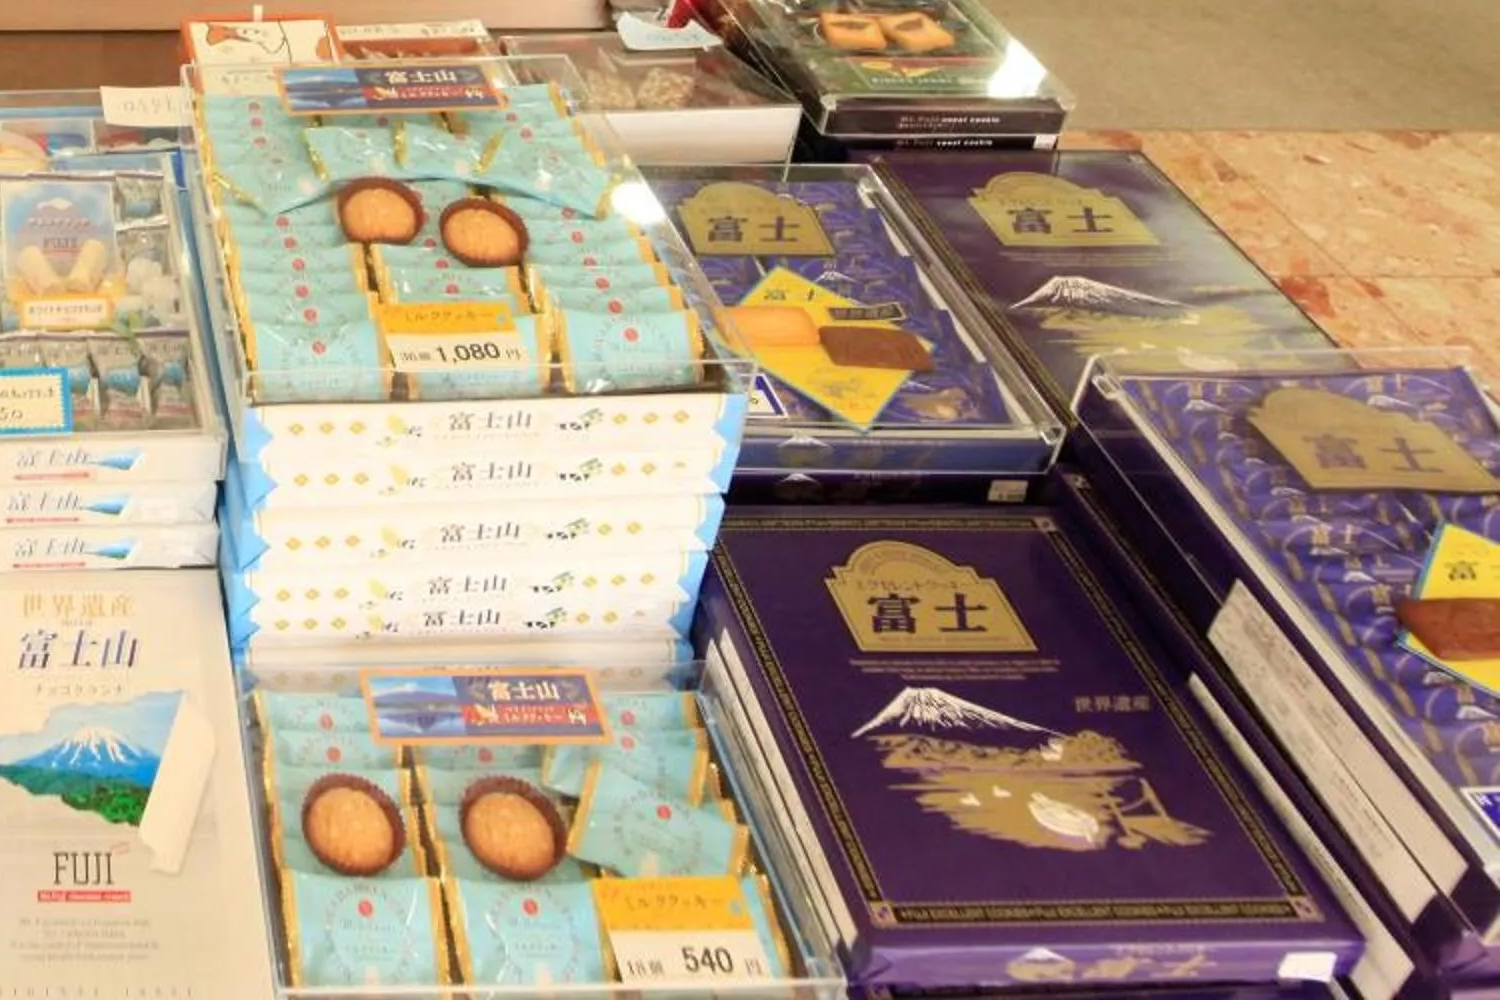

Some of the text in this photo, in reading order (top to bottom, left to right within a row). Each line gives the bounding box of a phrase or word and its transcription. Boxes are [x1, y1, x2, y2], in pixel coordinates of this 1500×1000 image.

[384, 69, 458, 84] 富士山
[708, 215, 800, 243] 富士
[1007, 207, 1114, 234] 富士
[437, 342, 500, 363] 1,080
[449, 410, 532, 431] 富士山
[1302, 432, 1446, 473] 富士
[451, 461, 533, 482] 富士山
[440, 522, 521, 543] 富士山
[427, 575, 508, 596] 富士山
[22, 593, 135, 619] 世界遺産
[867, 592, 988, 634] 富士
[422, 608, 501, 628] 富士山
[17, 628, 139, 670] 富士山
[487, 680, 561, 702] 富士山
[1073, 694, 1150, 714] 世界遺産
[52, 851, 115, 886] FUJI
[681, 946, 734, 974] 540
